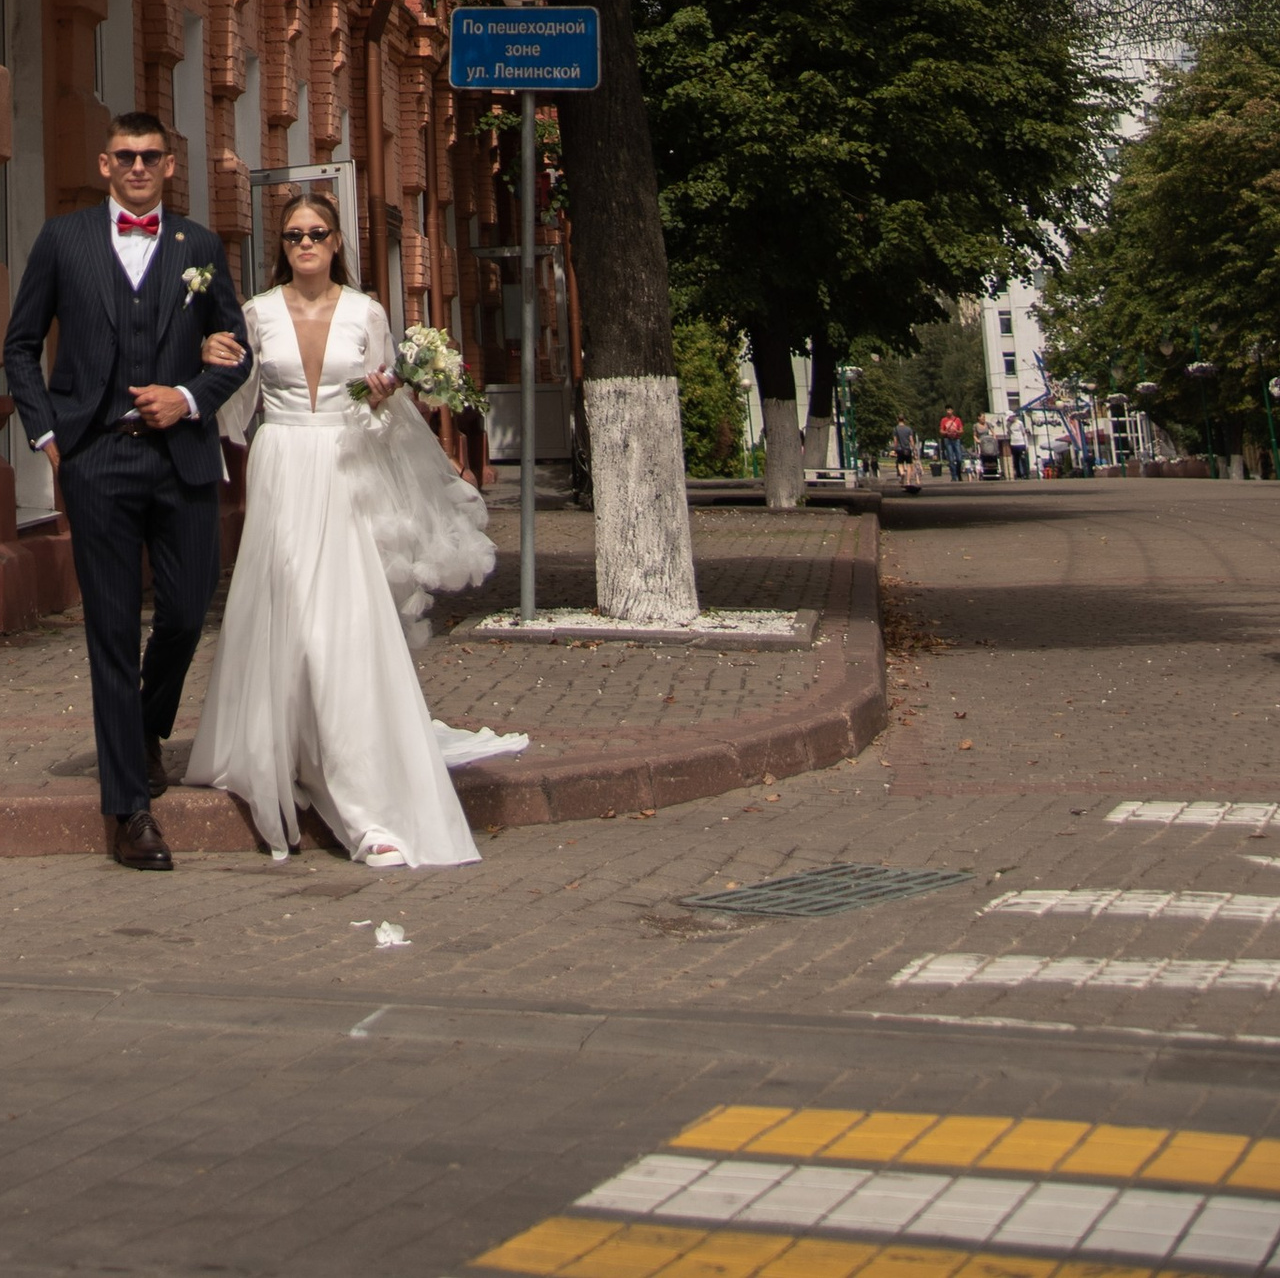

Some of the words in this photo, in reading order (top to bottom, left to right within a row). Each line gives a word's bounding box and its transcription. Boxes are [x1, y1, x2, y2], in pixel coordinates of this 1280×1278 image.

[462, 19, 484, 36] По
[487, 17, 586, 36] пешеходной
[504, 42, 541, 57] зоне
[466, 65, 490, 80] ул.
[494, 63, 581, 80] Ленинской
